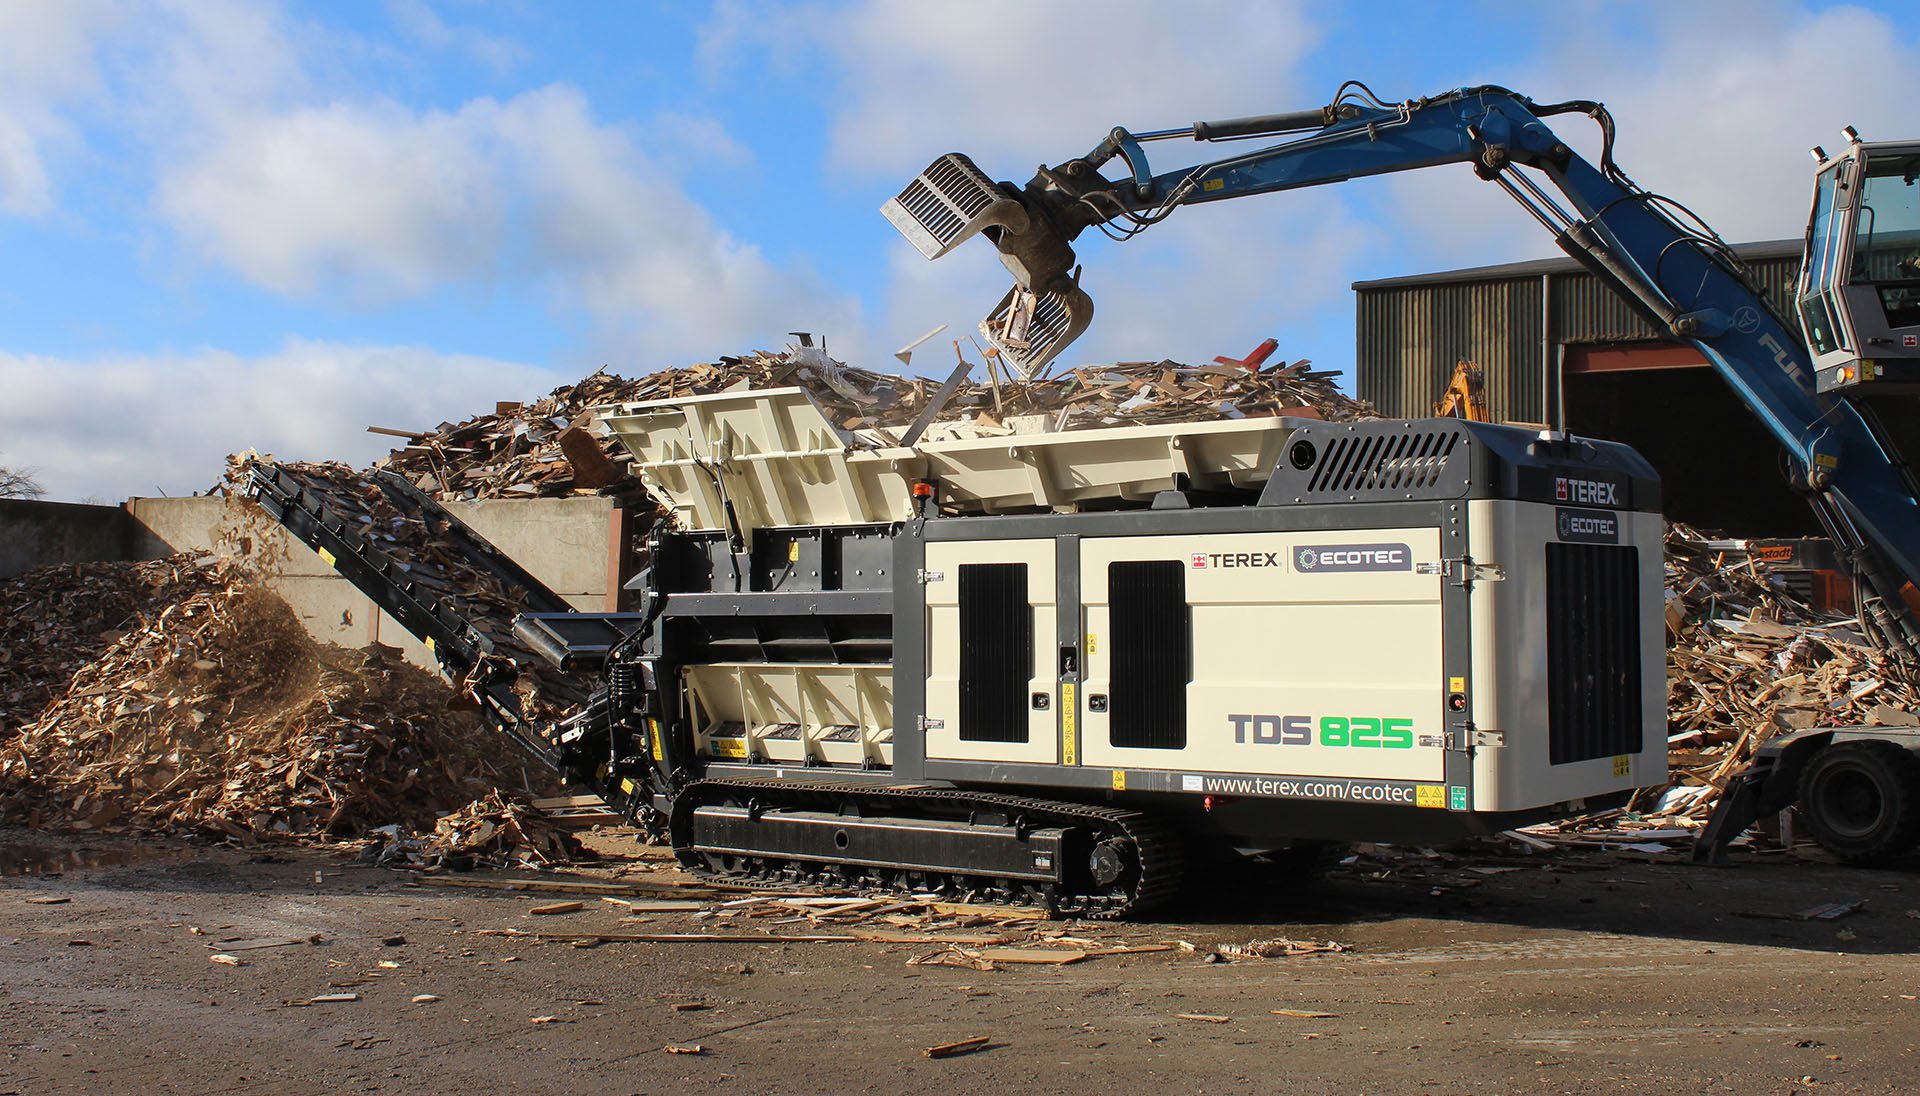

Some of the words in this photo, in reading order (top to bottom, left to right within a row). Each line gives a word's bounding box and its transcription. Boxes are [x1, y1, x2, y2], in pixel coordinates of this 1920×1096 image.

[1568, 479, 1616, 505] TEREX
[1571, 517, 1615, 535] ECOTEC
[1209, 552, 1279, 568] TEREX
[1320, 550, 1403, 565] ECOTEC
[1761, 547, 1791, 559] stadt
[1228, 714, 1312, 746] TDS
[1319, 716, 1413, 749] 825
[1206, 777, 1413, 802] www.terex.com/ecotec
